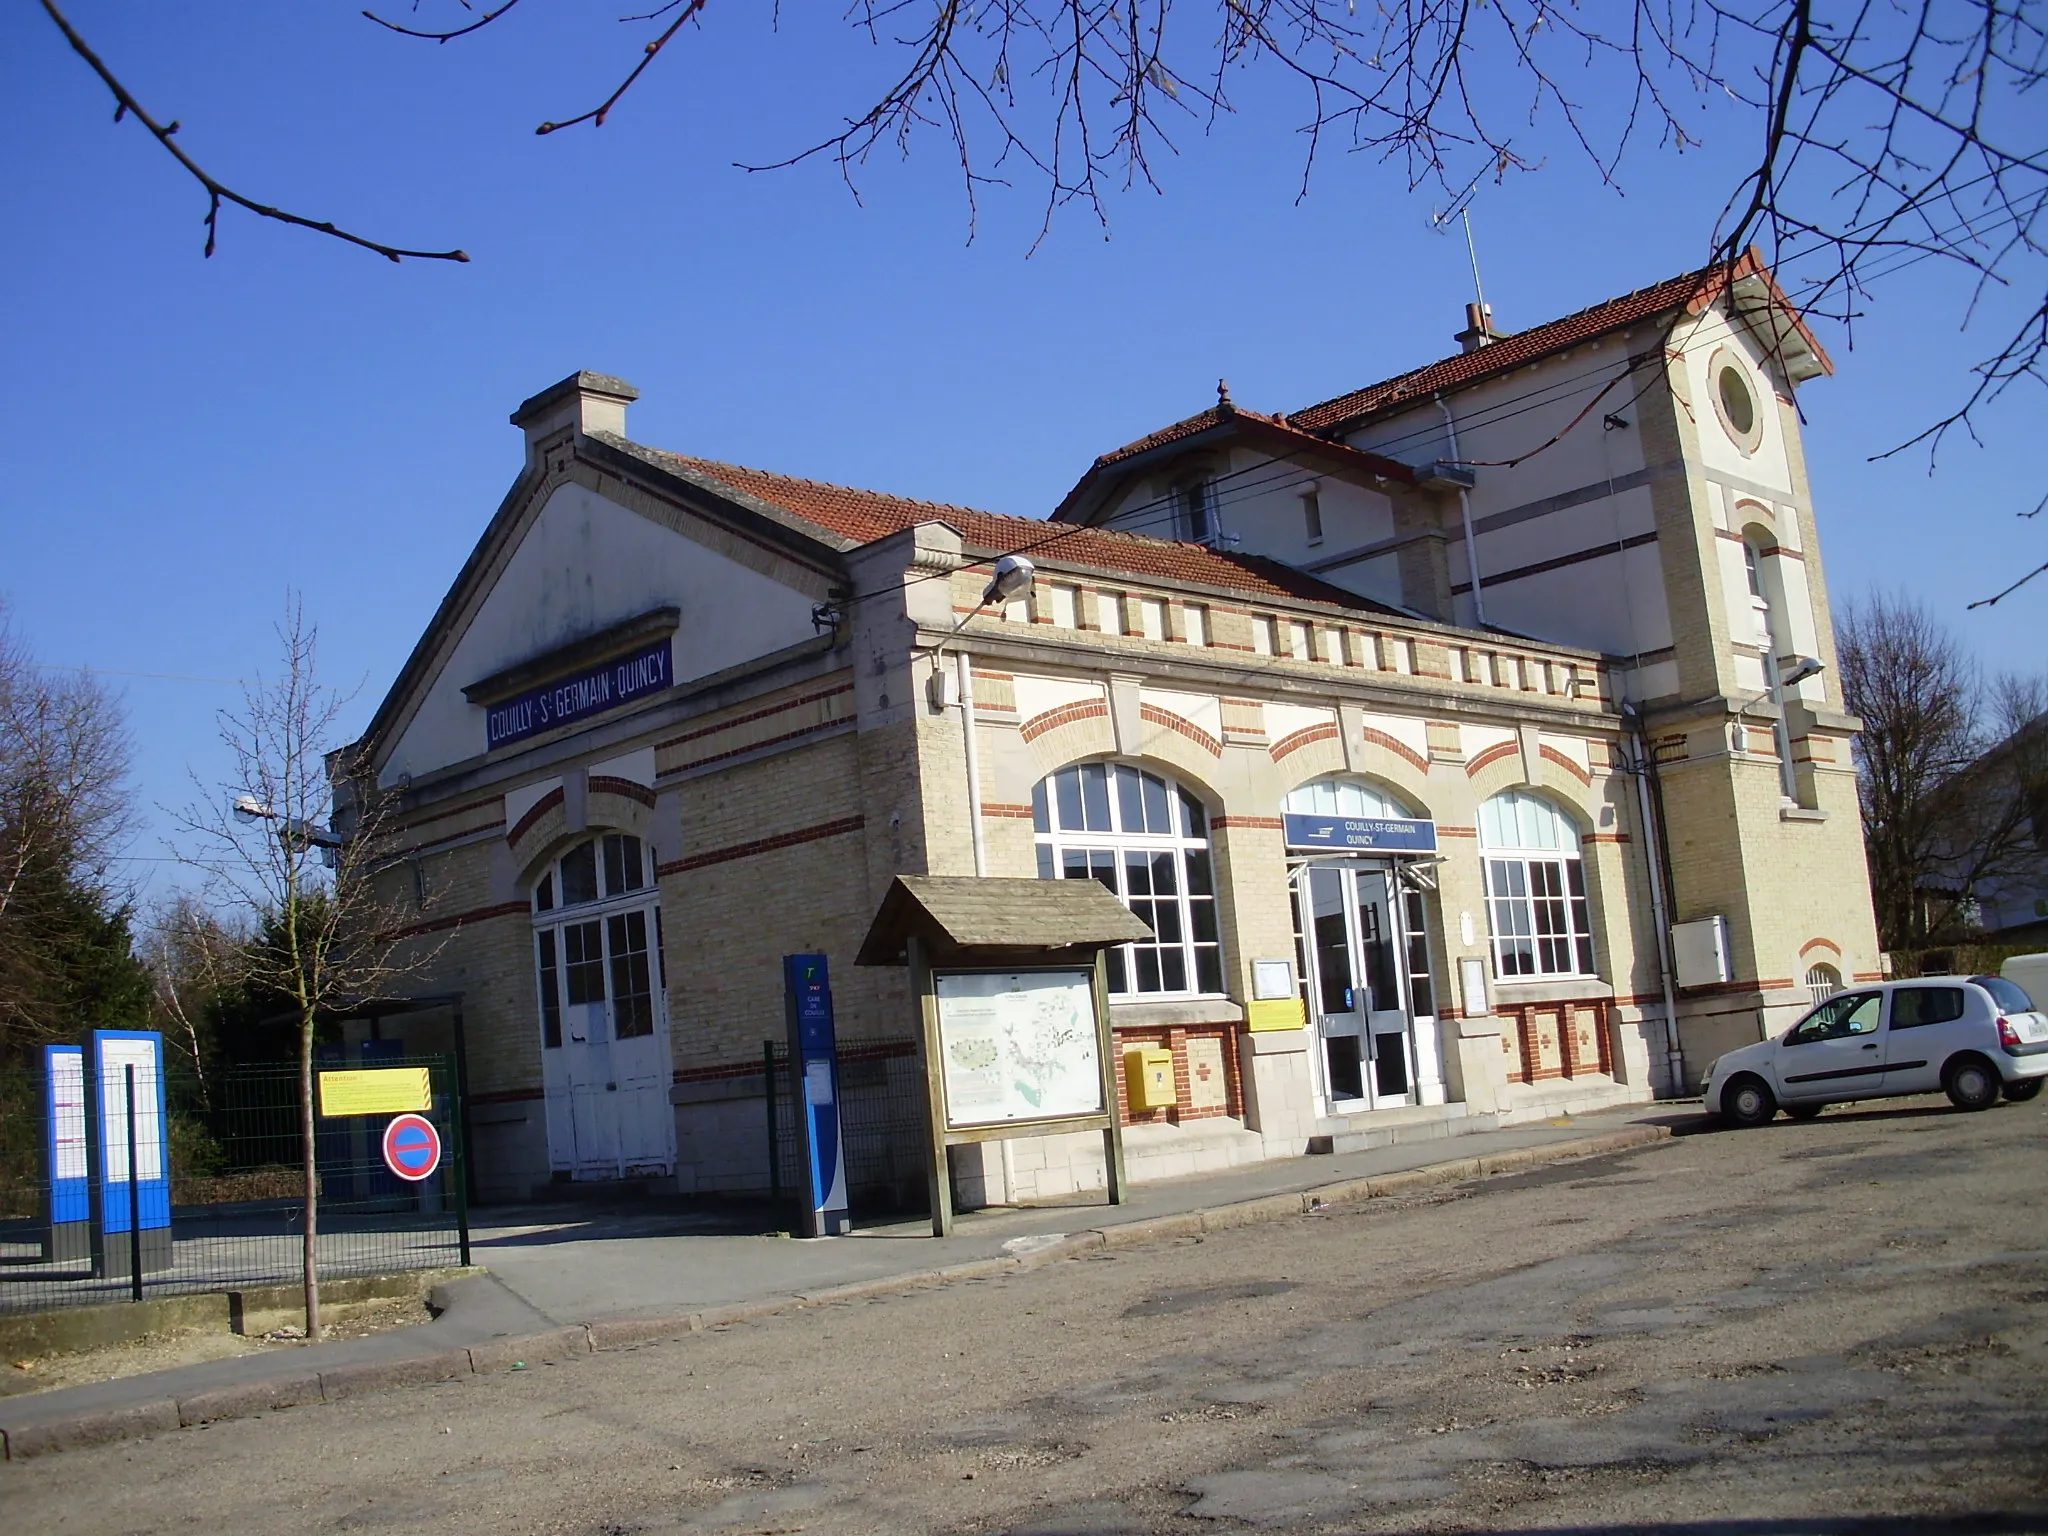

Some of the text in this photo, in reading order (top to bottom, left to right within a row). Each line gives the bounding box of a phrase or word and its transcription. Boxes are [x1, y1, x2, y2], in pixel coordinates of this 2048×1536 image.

[491, 700, 533, 741] COUILLY
[555, 671, 610, 718] GERMAIN
[617, 650, 665, 698] QUINCY
[1344, 821, 1416, 834] COUILLY-ST-GERMAIN
[1346, 834, 1373, 845] QUINCY
